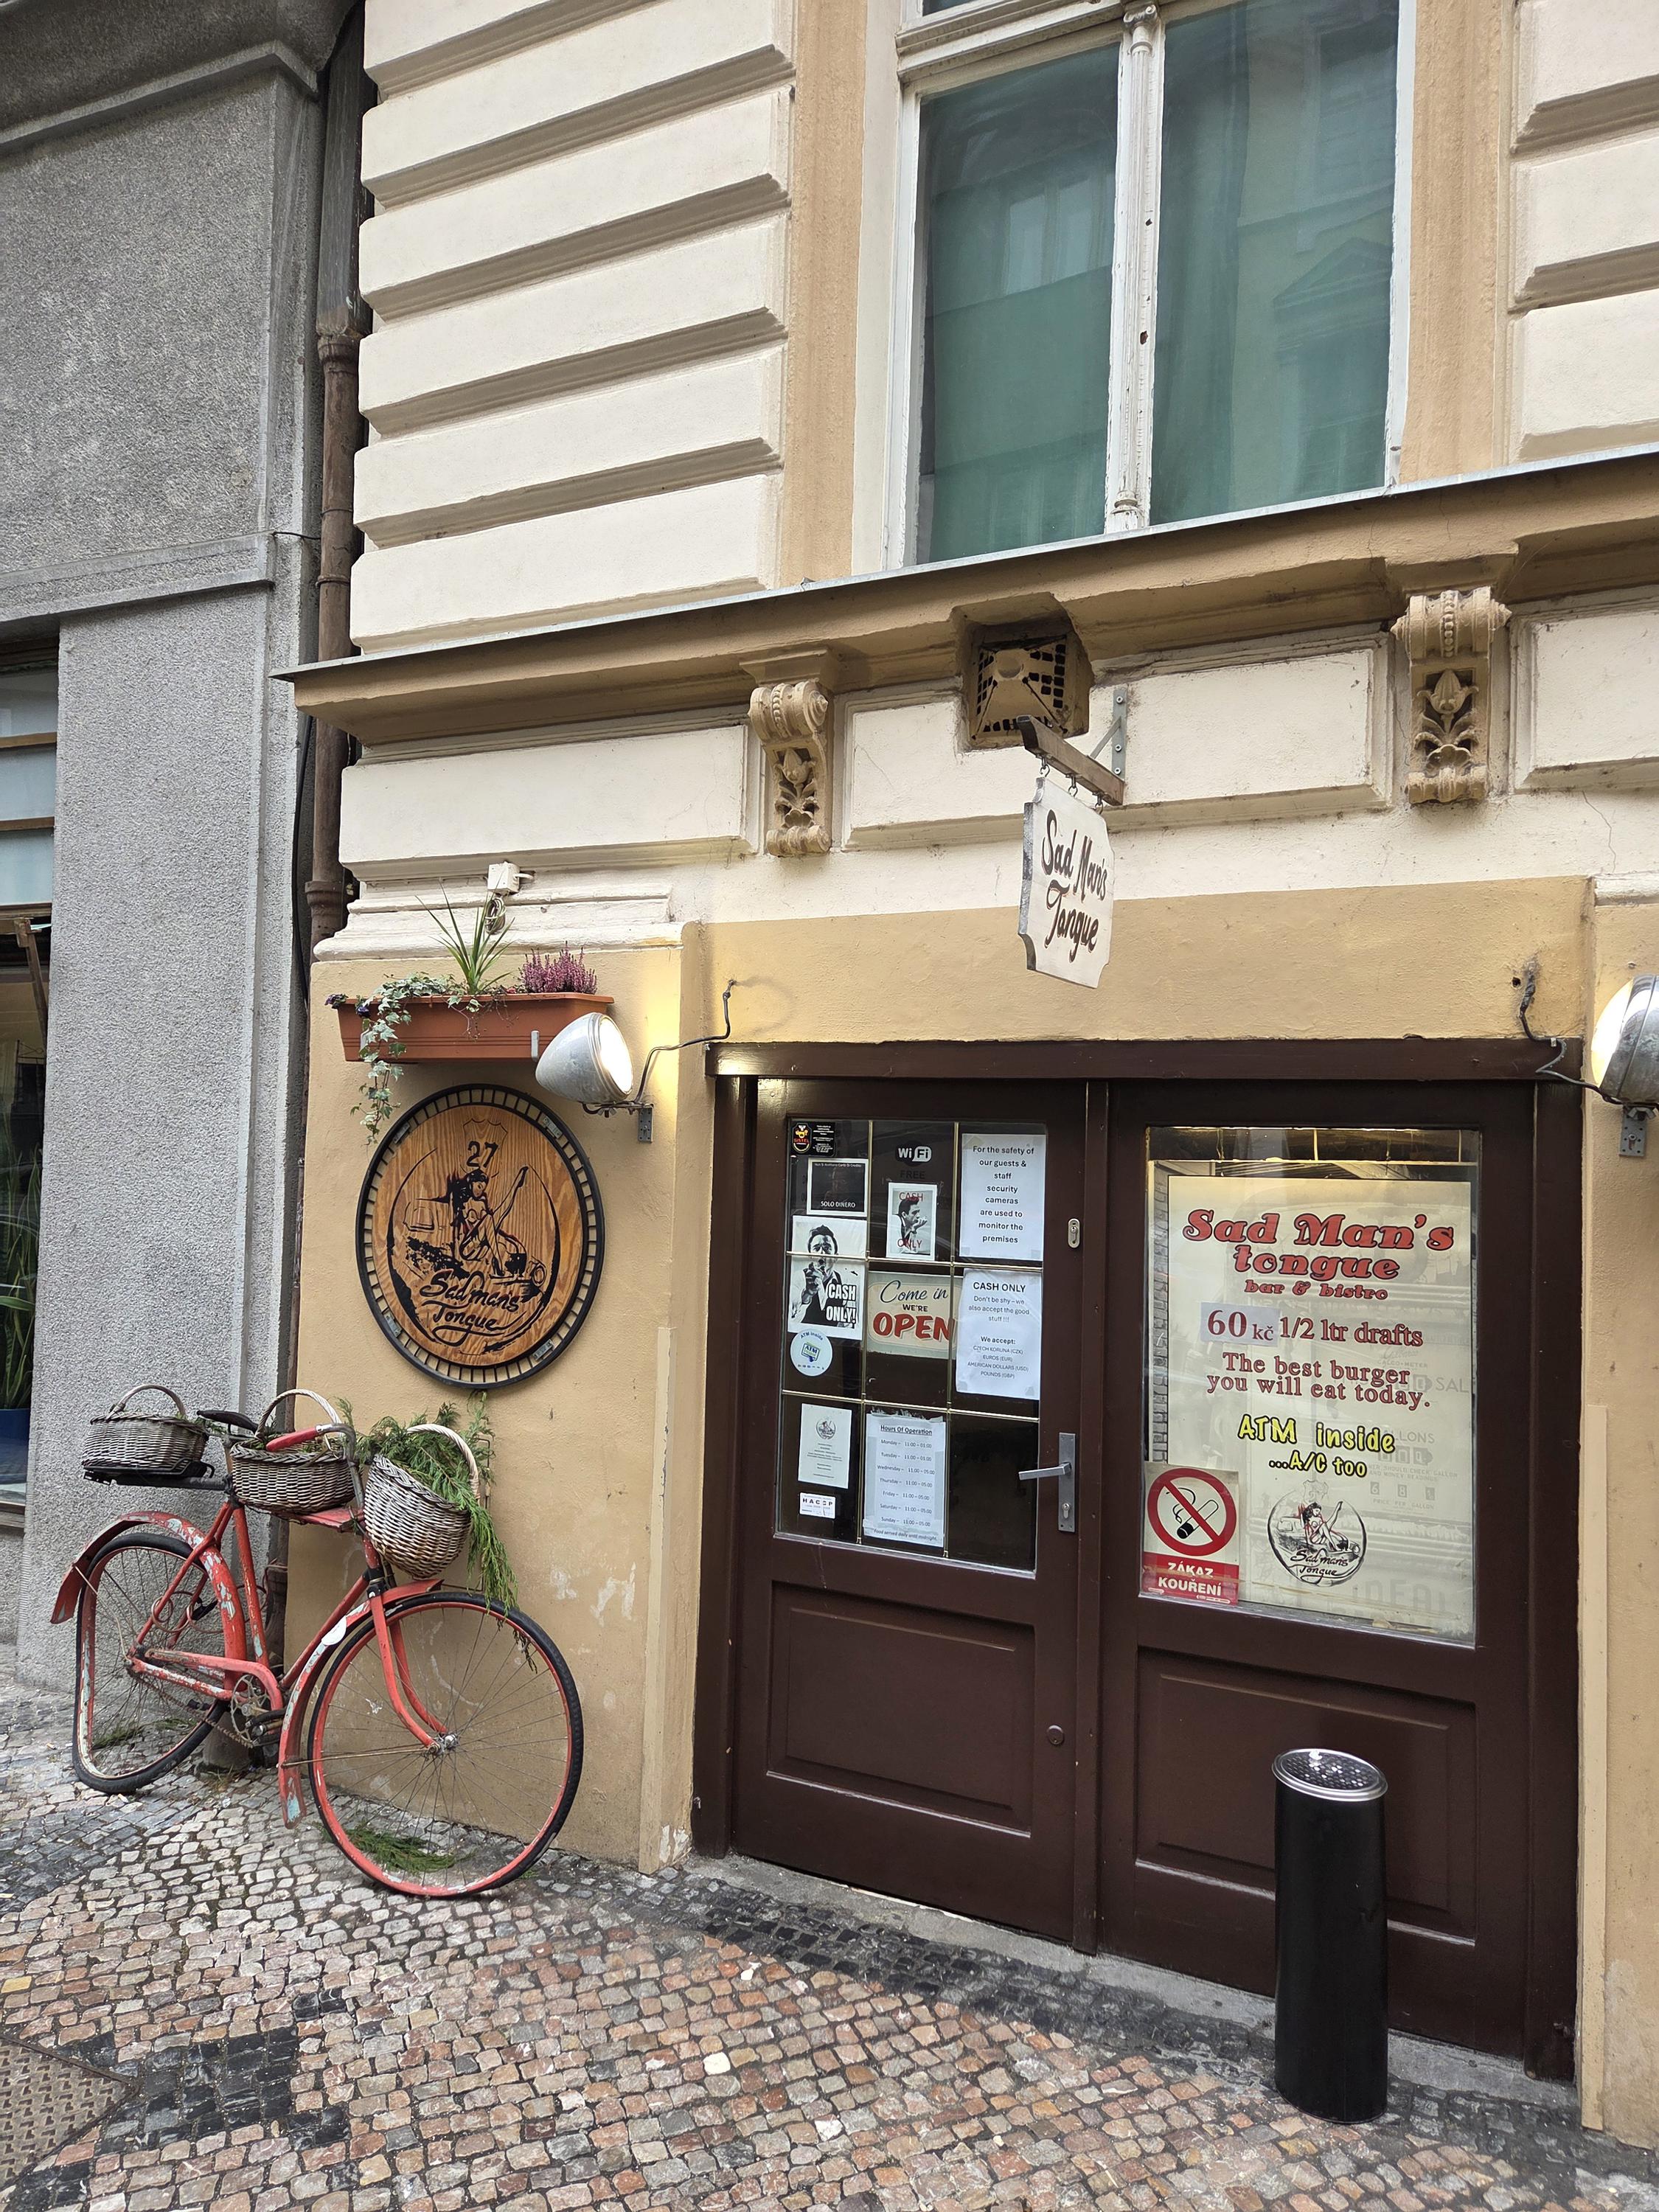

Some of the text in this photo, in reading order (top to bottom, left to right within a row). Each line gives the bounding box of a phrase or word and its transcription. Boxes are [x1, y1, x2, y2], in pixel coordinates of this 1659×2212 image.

[1041, 809, 1077, 878] Sad
[466, 1141, 499, 1168] 27
[1001, 1147, 1025, 1156] safety
[900, 1170, 925, 1179] FREE
[899, 1192, 924, 1201] CASH
[987, 1185, 1018, 1194] security
[982, 1235, 1018, 1243] premises
[1182, 1208, 1454, 1251] Sad Man's
[897, 1238, 922, 1249] ONLY
[1233, 1244, 1400, 1281] tongue
[420, 1268, 484, 1302] Sad
[828, 1283, 856, 1301] CASH
[880, 1280, 949, 1303] Come in
[973, 1282, 1026, 1293] CASH ONLY
[1244, 1279, 1388, 1301] bar & bistro
[826, 1306, 856, 1324] ONLY!
[902, 1304, 928, 1312] WE'RE
[422, 1299, 525, 1346] Tongue
[873, 1312, 954, 1341] OPEN
[1207, 1310, 1247, 1338] 60
[1252, 1323, 1274, 1341] kč
[1280, 1316, 1315, 1340] 1/2
[1320, 1318, 1349, 1342] ltr
[1354, 1321, 1424, 1347] drafts
[805, 1345, 818, 1354] ATM
[1222, 1352, 1411, 1388] The best burger
[1206, 1374, 1431, 1411] you will eat today.
[904, 1427, 932, 1435] Operation
[1237, 1413, 1396, 1453] ATM inside
[1269, 1450, 1368, 1478] ...A/C too
[1290, 1548, 1326, 1563] Sad
[1168, 1561, 1214, 1578] ZÁKAZ
[1289, 1564, 1354, 1585] Tongue
[1158, 1576, 1222, 1596] KOUŘENÍ
